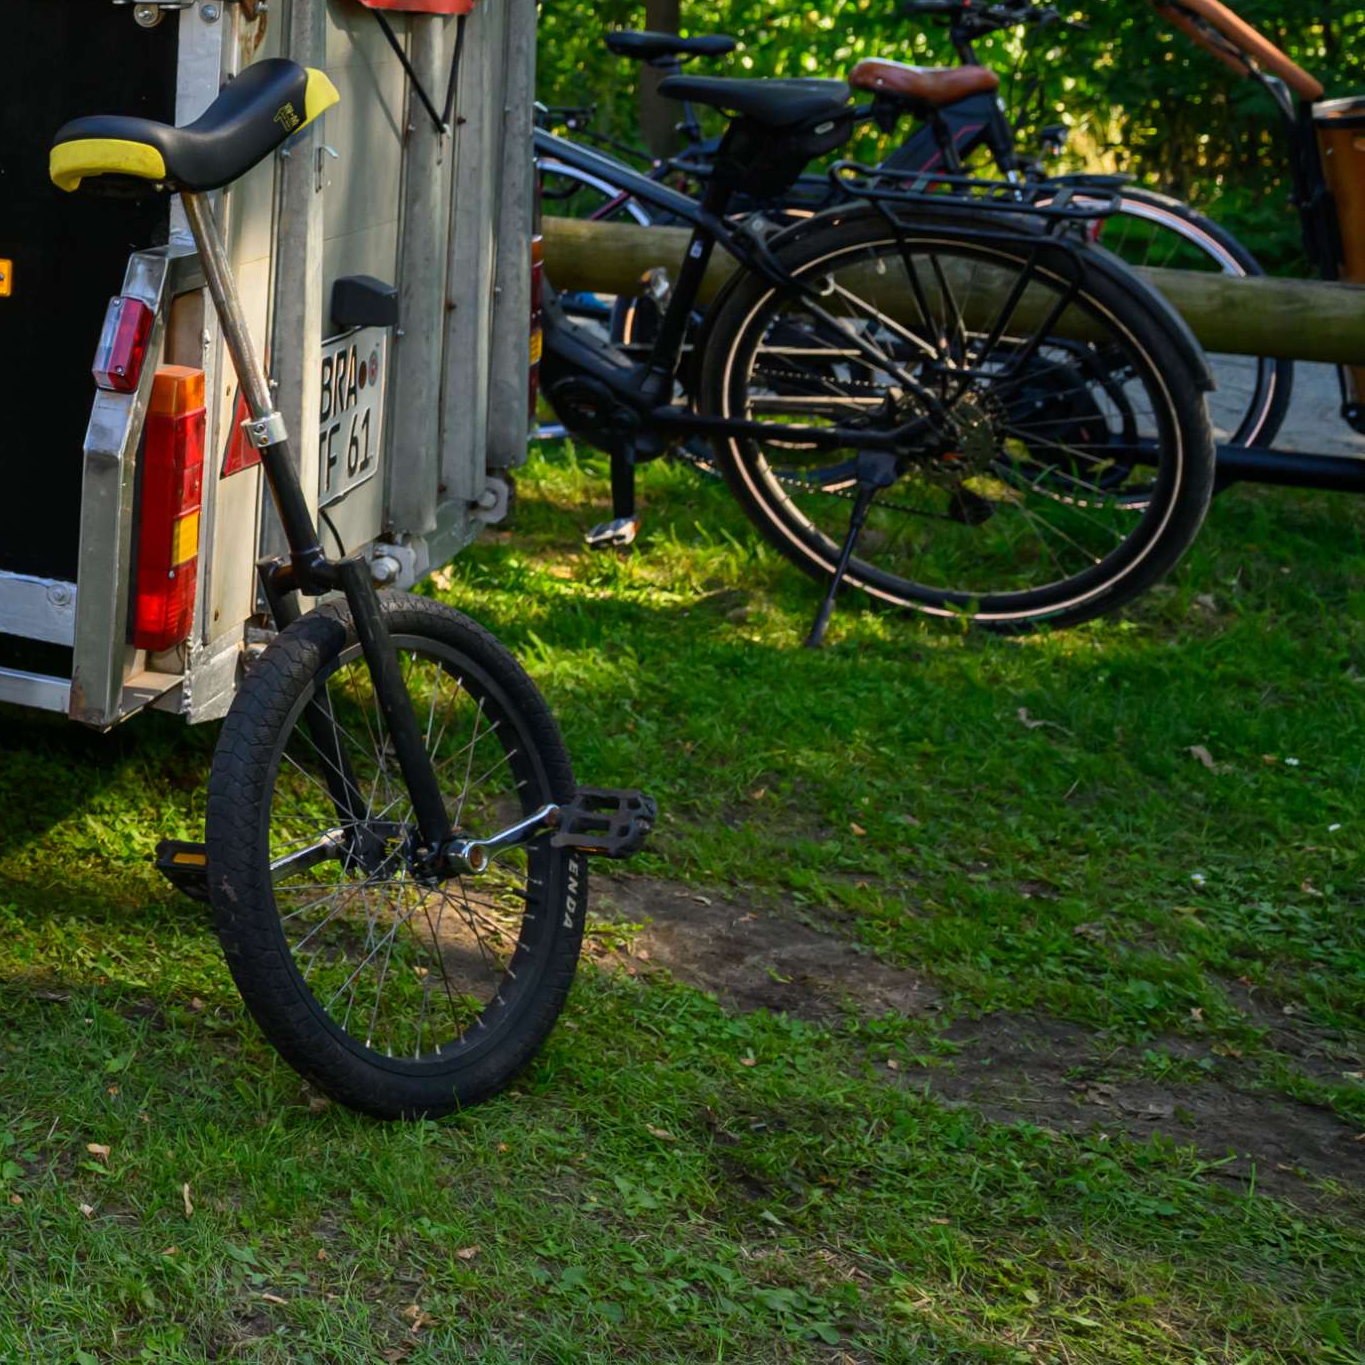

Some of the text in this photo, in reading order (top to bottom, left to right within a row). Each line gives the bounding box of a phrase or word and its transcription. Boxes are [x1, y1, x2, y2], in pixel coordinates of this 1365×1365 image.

[319, 344, 357, 423] BRA
[347, 407, 373, 479] 61
[563, 852, 579, 929] ENDA
